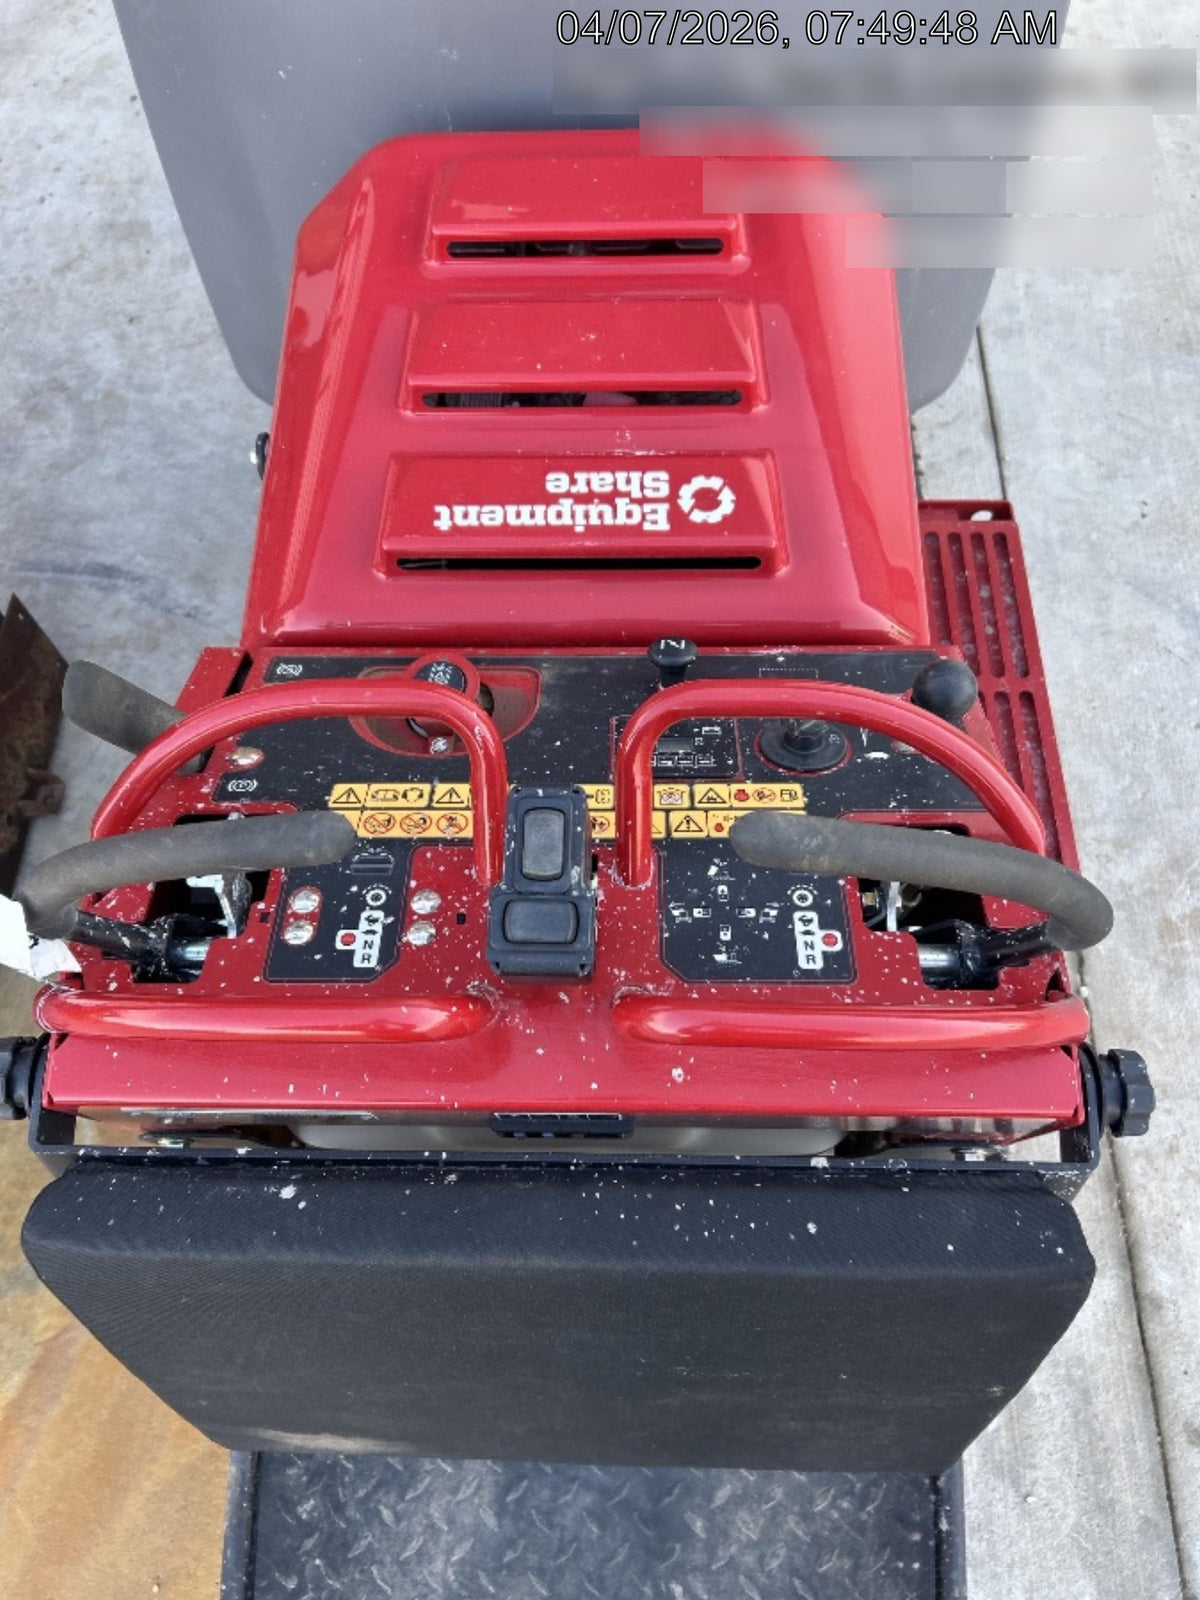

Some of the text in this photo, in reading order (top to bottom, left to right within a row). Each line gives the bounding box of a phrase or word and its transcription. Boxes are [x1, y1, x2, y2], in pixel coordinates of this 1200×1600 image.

[545, 470, 670, 498] Share
[434, 497, 671, 532] Equipment
[362, 939, 374, 950] N
[803, 940, 815, 951] N
[361, 952, 372, 964] R
[805, 953, 817, 965] R
